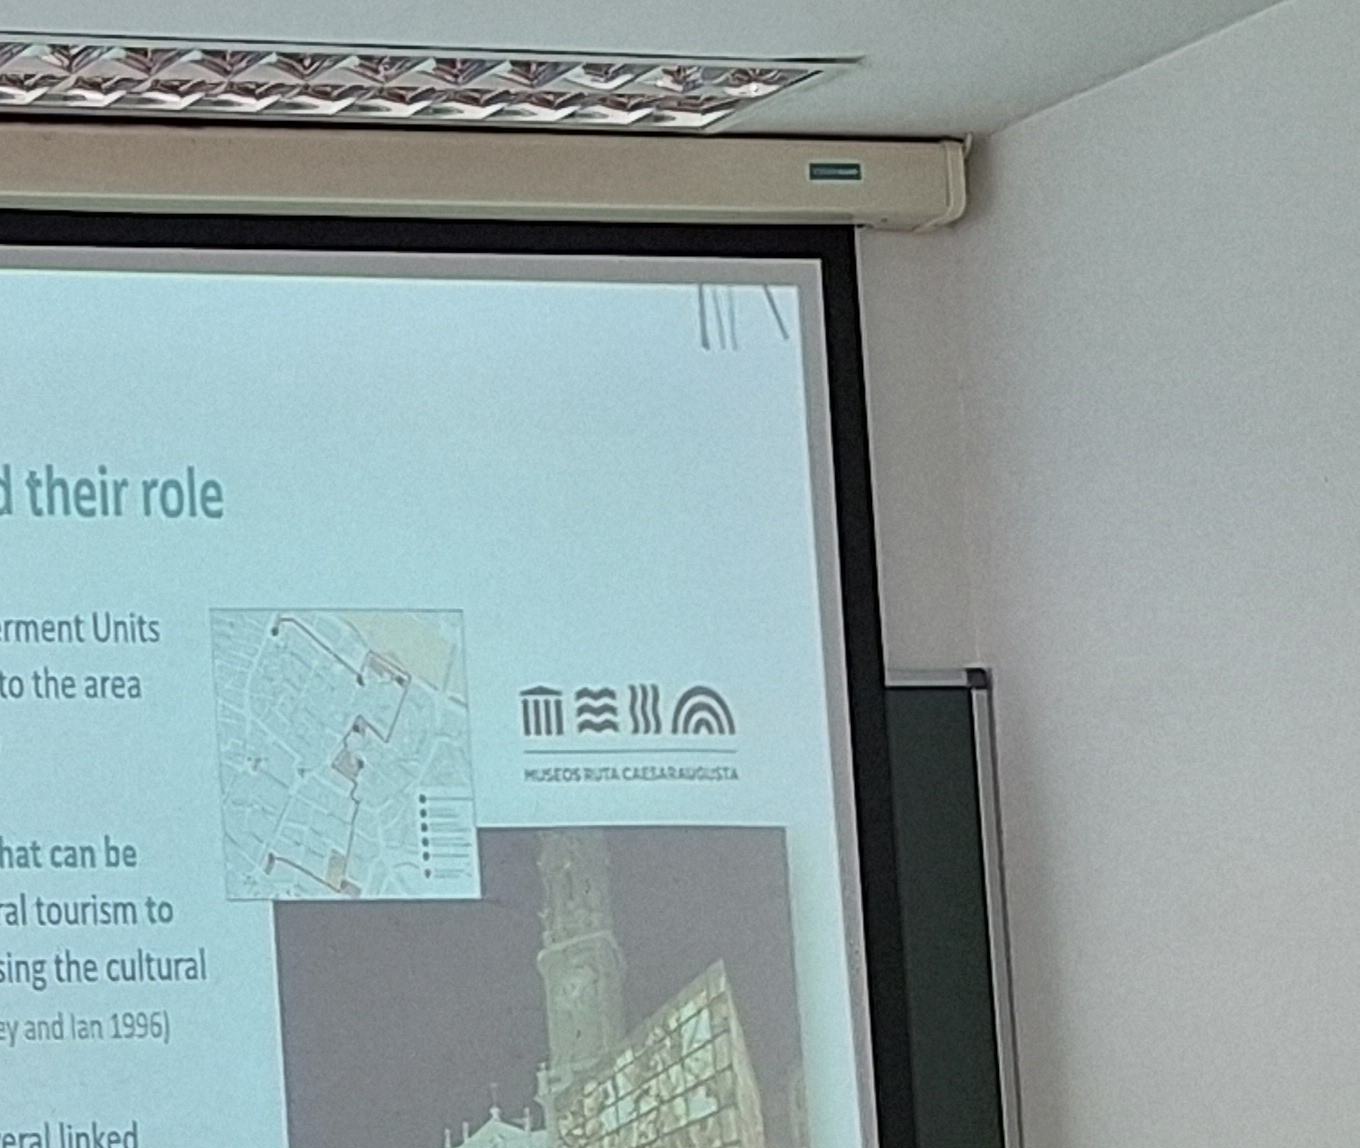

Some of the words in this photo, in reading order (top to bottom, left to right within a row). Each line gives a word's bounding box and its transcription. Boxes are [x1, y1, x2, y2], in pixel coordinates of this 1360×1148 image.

[25, 463, 129, 518] their
[141, 465, 224, 519] role
[91, 611, 161, 644] Units
[31, 666, 77, 700] the
[84, 675, 142, 700] area
[524, 767, 580, 782] MUSEOS
[585, 767, 619, 781] RUTA
[49, 844, 97, 869] can
[103, 834, 137, 868] be
[34, 893, 139, 927] tourism
[144, 896, 174, 925] to
[53, 949, 98, 983] the
[106, 947, 207, 983] cultural
[24, 1011, 65, 1041] and
[69, 1013, 104, 1041] Ian
[110, 1010, 171, 1045] 1996)
